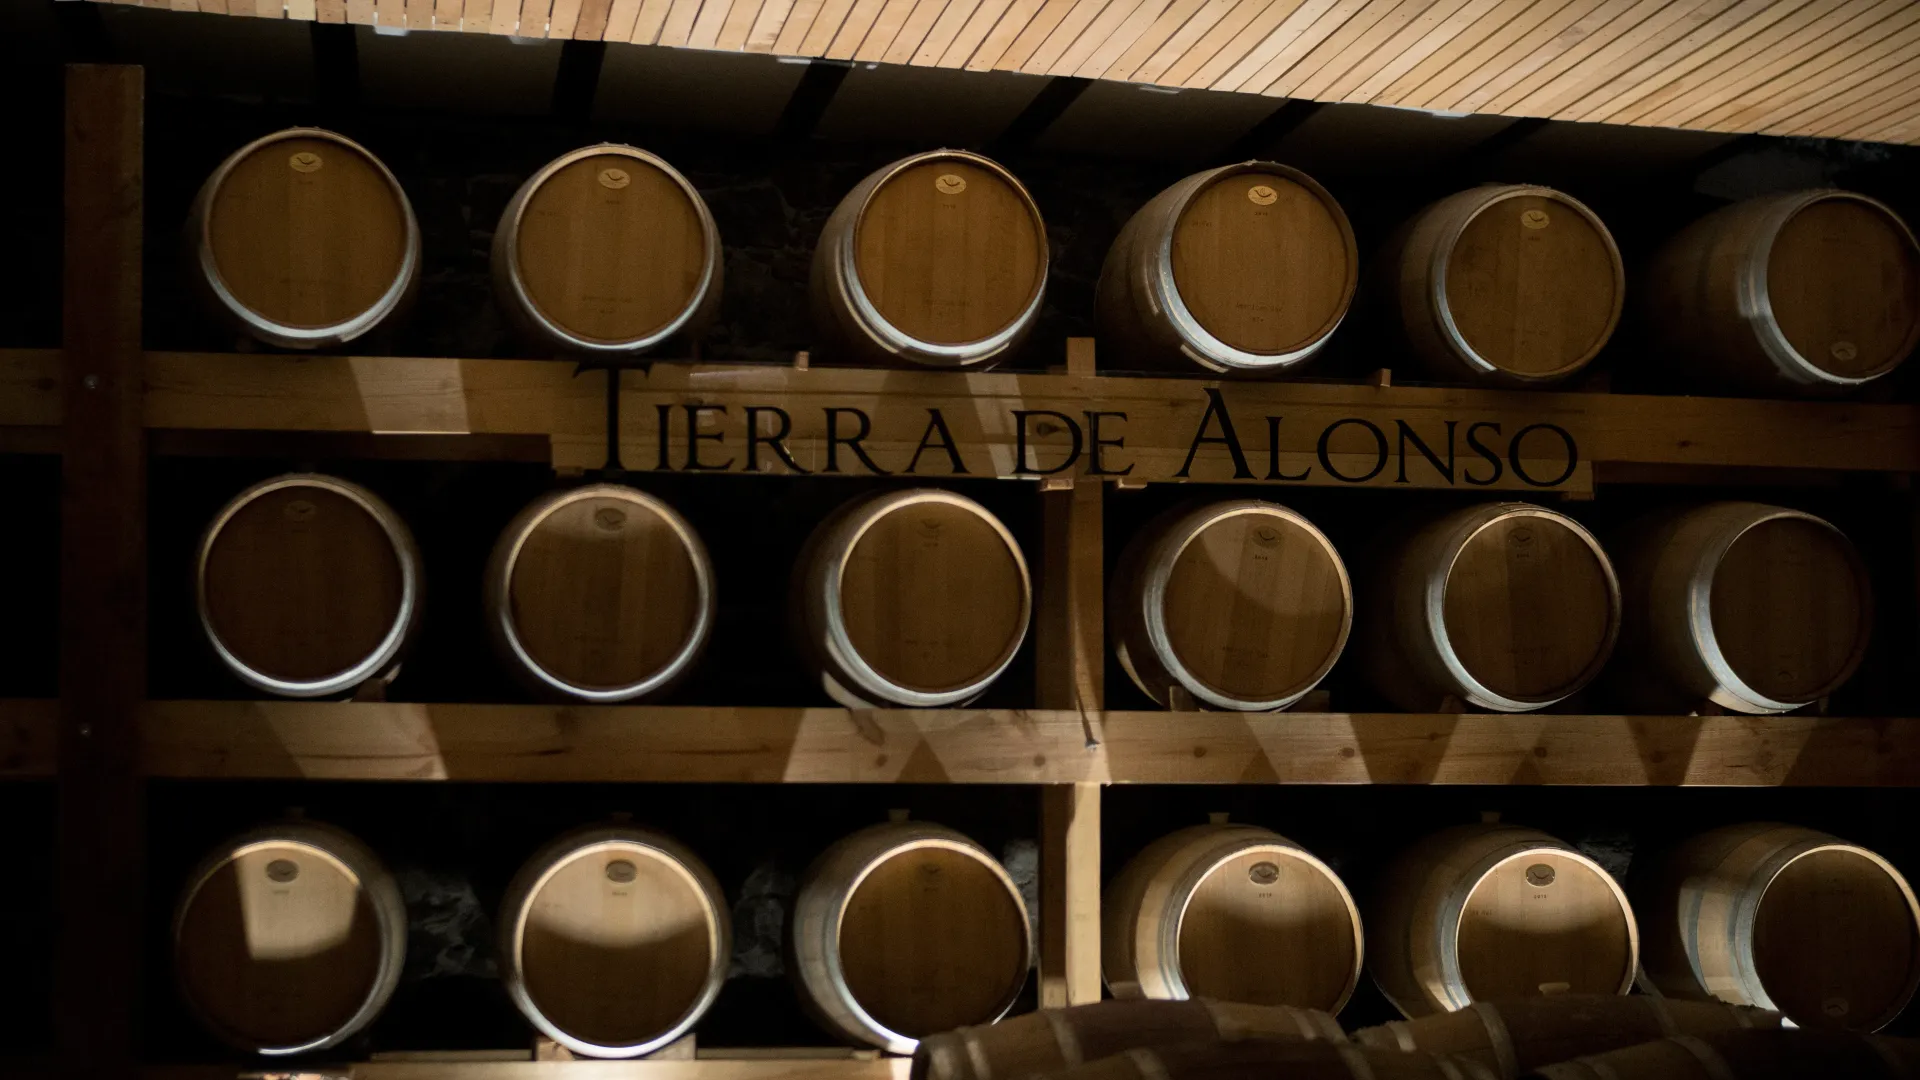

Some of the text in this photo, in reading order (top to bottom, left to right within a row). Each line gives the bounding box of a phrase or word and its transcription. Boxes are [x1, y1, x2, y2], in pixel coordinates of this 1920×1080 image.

[573, 362, 1578, 487] TIERRA DE ALONSO
